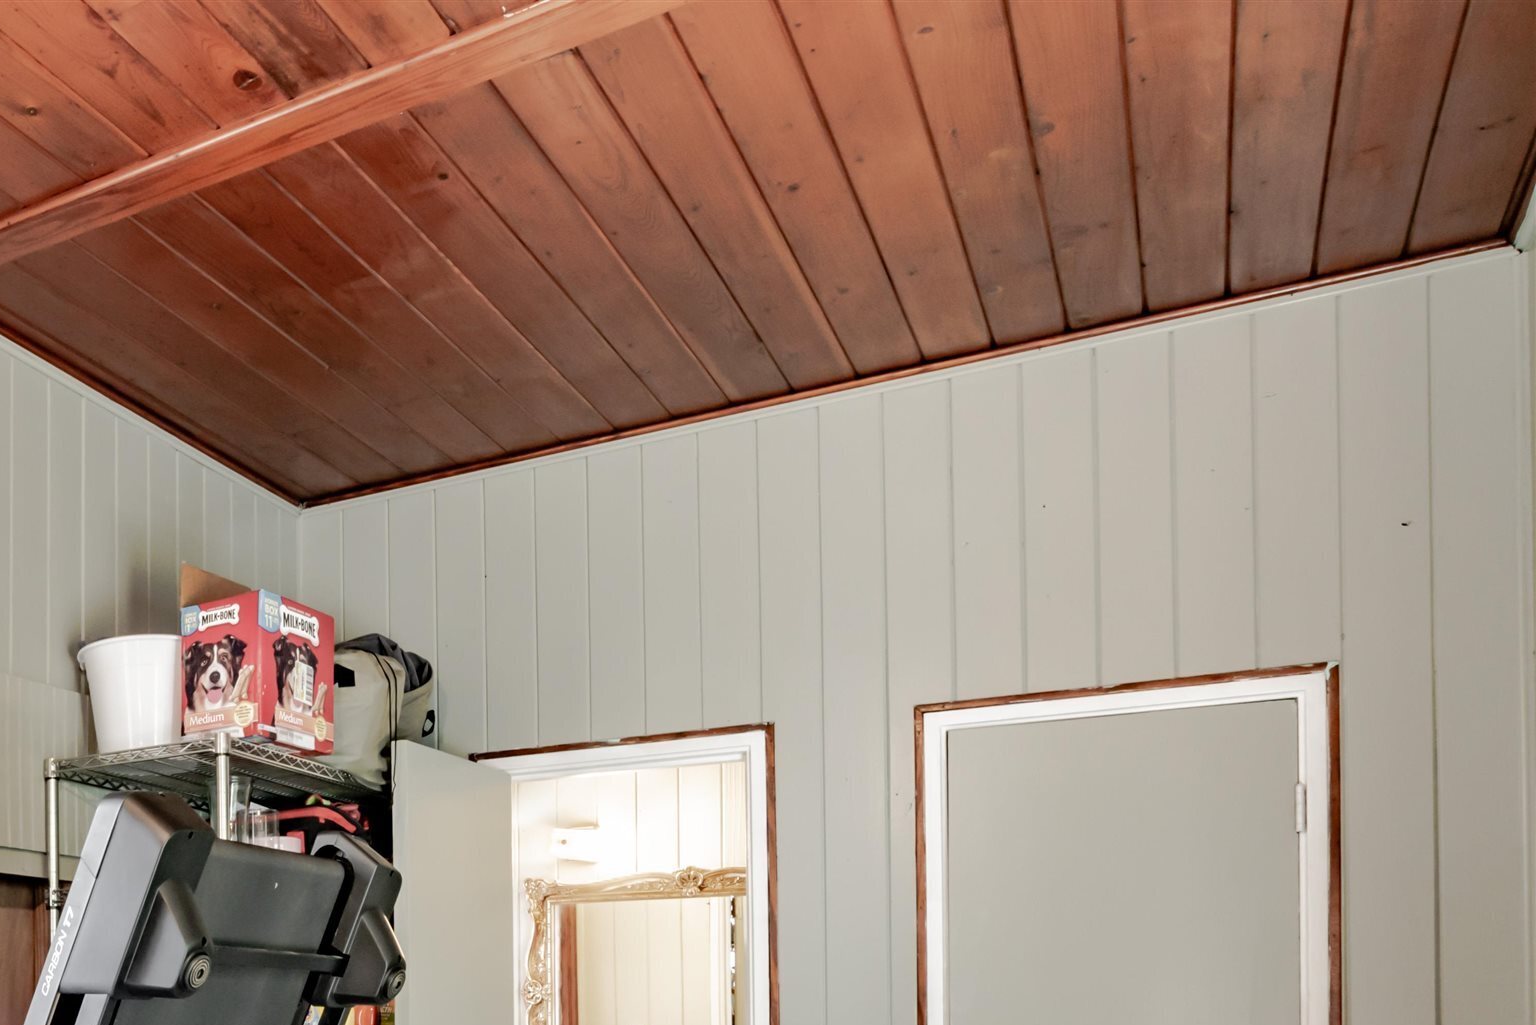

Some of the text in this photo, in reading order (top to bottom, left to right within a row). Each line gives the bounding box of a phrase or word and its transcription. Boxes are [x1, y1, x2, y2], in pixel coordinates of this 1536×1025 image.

[189, 711, 225, 726] Medium
[278, 711, 304, 726] Medium
[41, 905, 74, 997] CARBON T7
